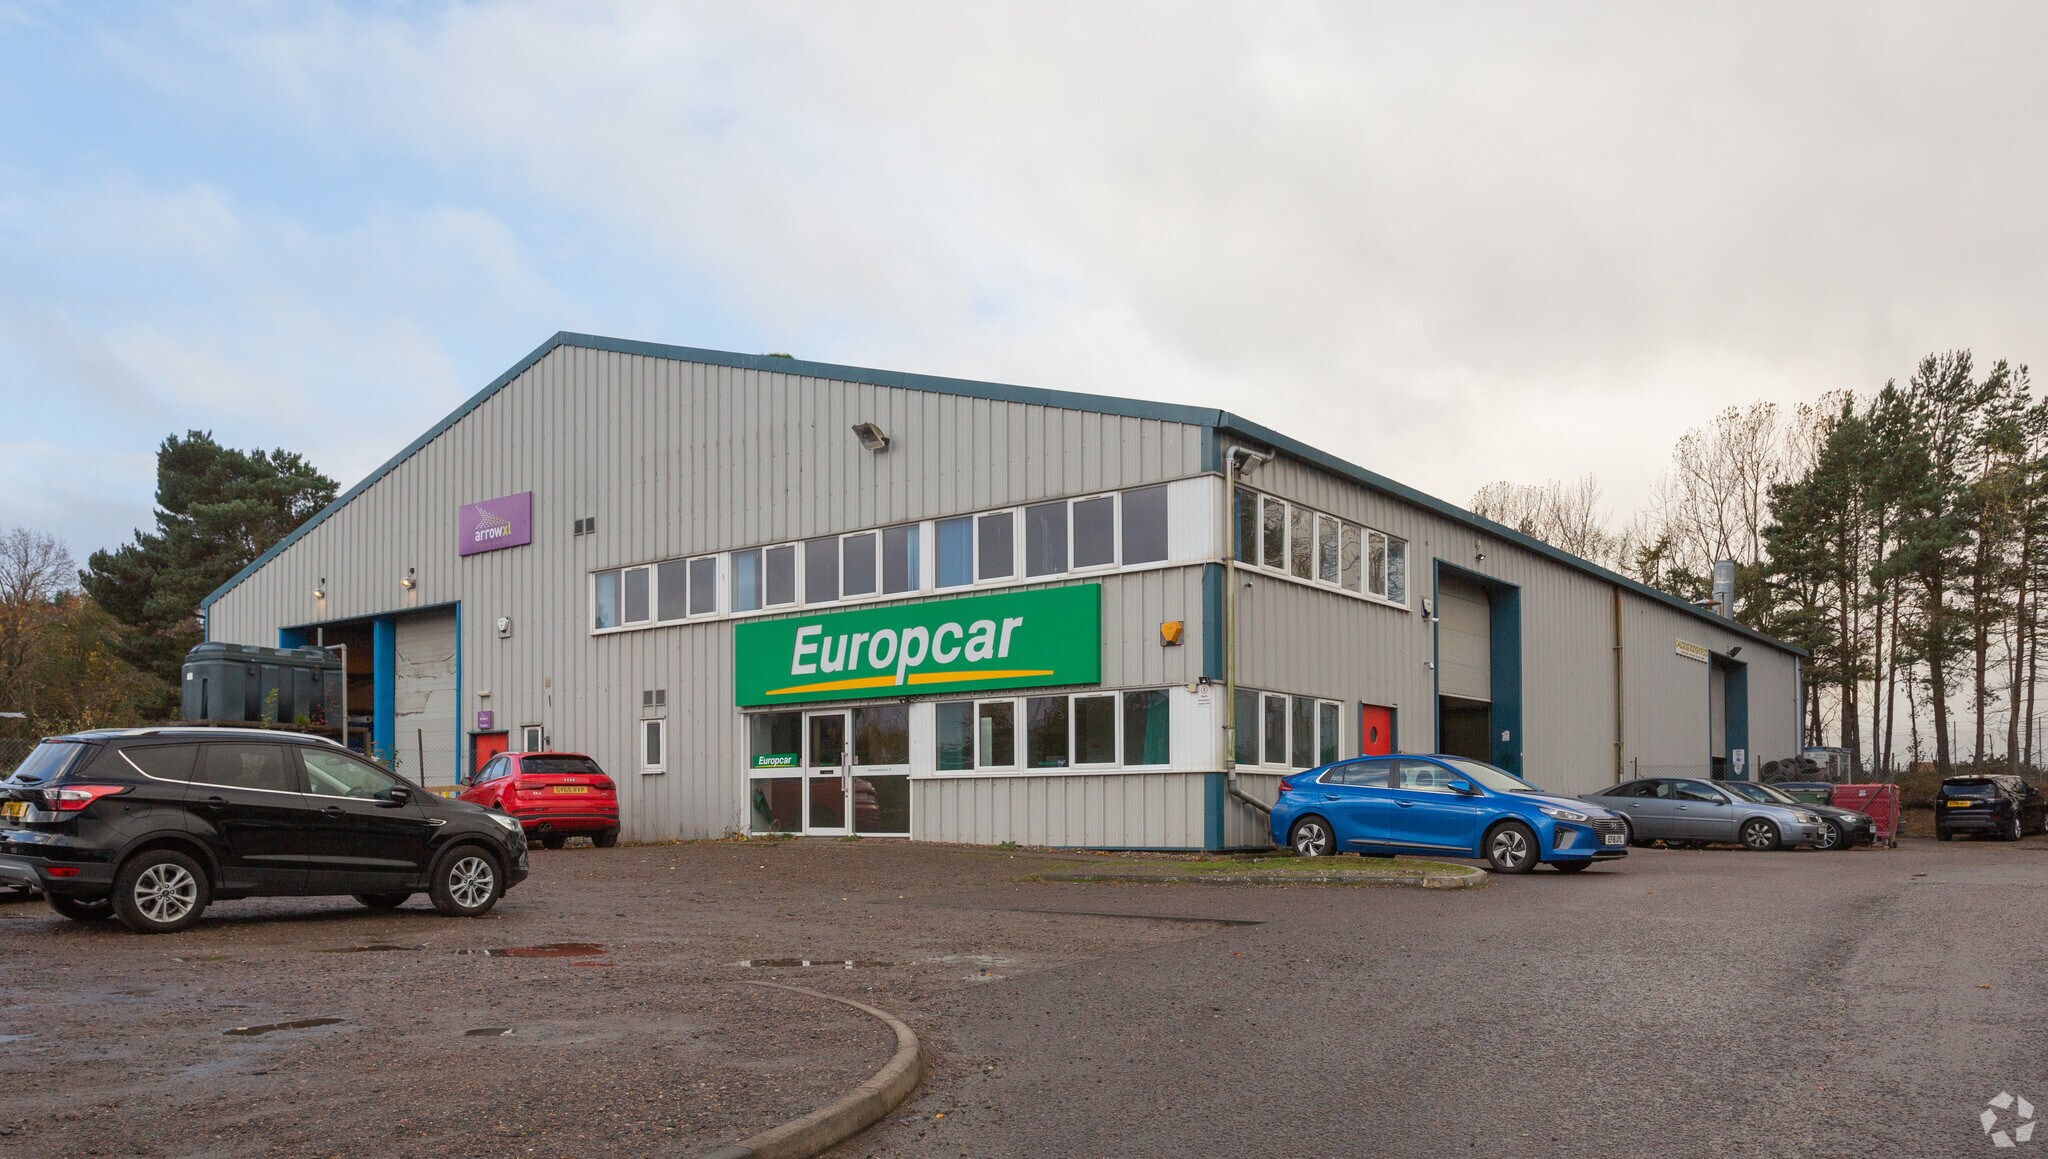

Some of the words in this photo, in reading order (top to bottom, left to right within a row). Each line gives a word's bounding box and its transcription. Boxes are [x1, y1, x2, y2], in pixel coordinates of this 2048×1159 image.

[475, 521, 512, 542] arrowxl
[790, 616, 1024, 686] Europcar
[758, 755, 793, 767] Europcar
